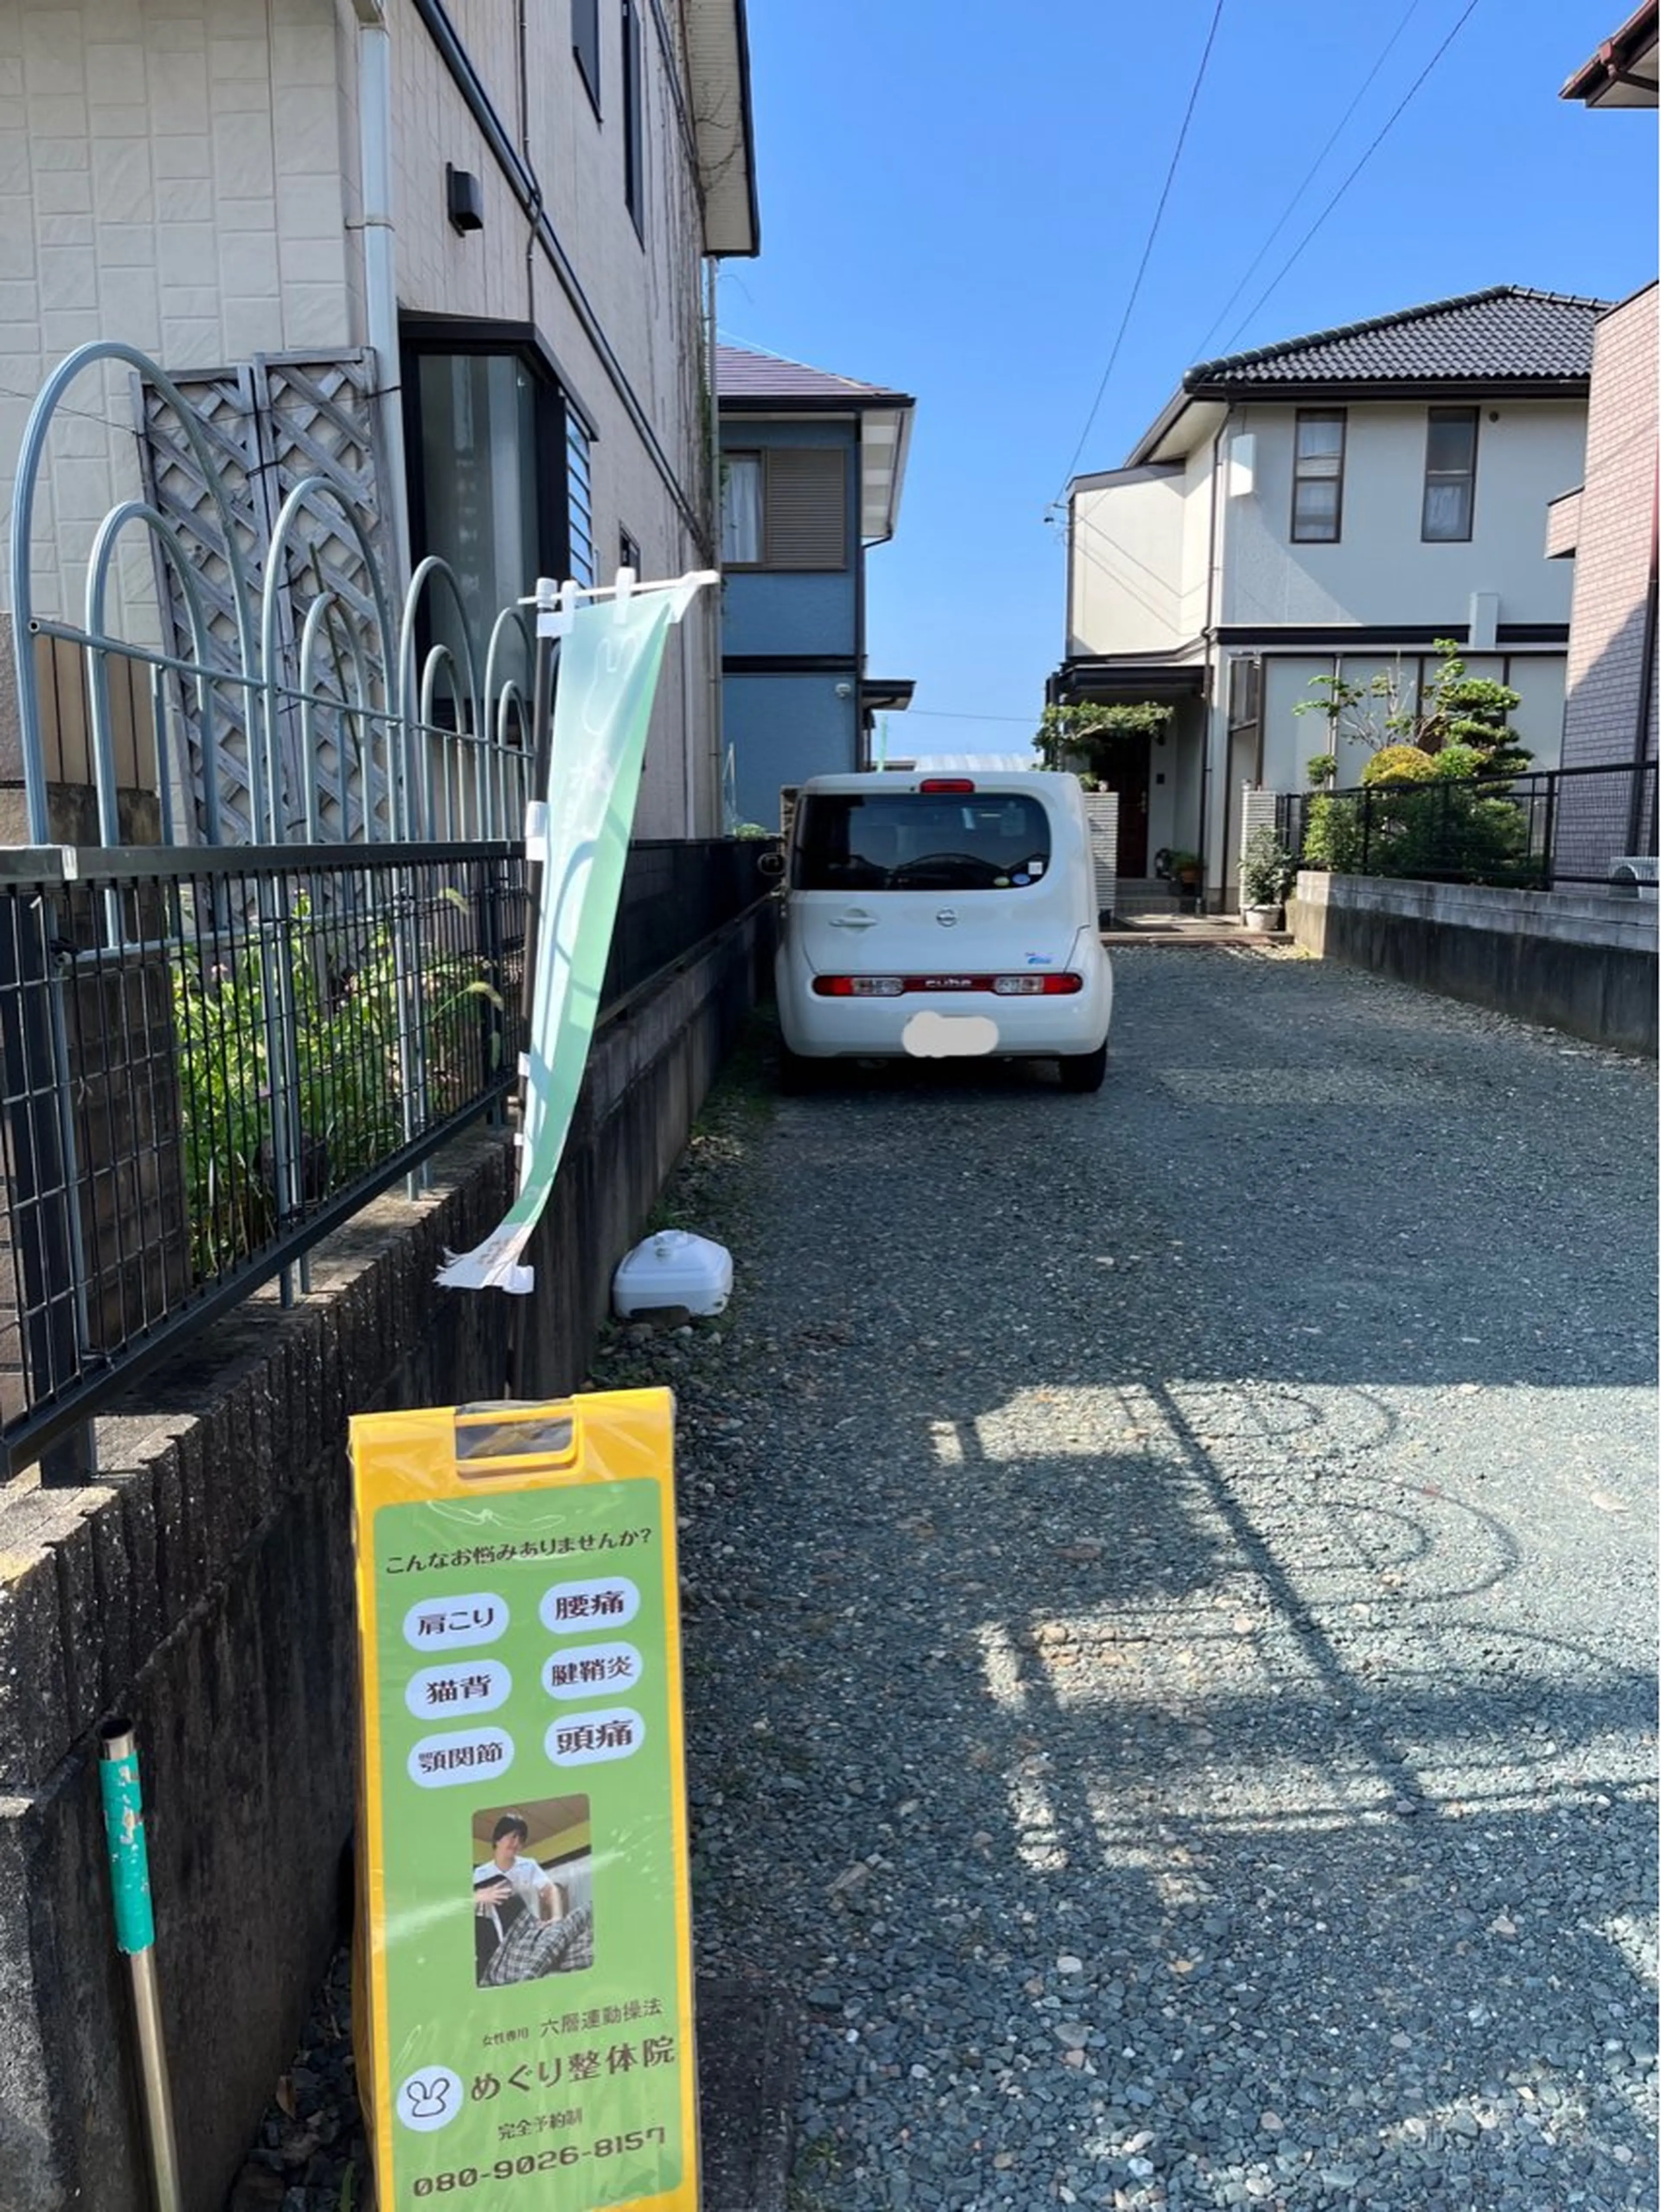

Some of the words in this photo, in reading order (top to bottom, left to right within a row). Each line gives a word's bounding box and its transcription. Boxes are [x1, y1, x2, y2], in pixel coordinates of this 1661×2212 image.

[386, 1528, 652, 1574] こんなお悩みありませんか?
[417, 1607, 494, 1636] 肩こり
[555, 1590, 625, 1620] 腰痛
[551, 1655, 634, 1686] 腱鞘炎
[426, 1674, 492, 1705] 猫背
[556, 1719, 634, 1755] 頭痛
[418, 1742, 503, 1774] 顎関節
[471, 2035, 675, 2101] めぐり整体院
[498, 2107, 583, 2141] 完全予約制
[413, 2126, 666, 2197] 080-9026-8157
